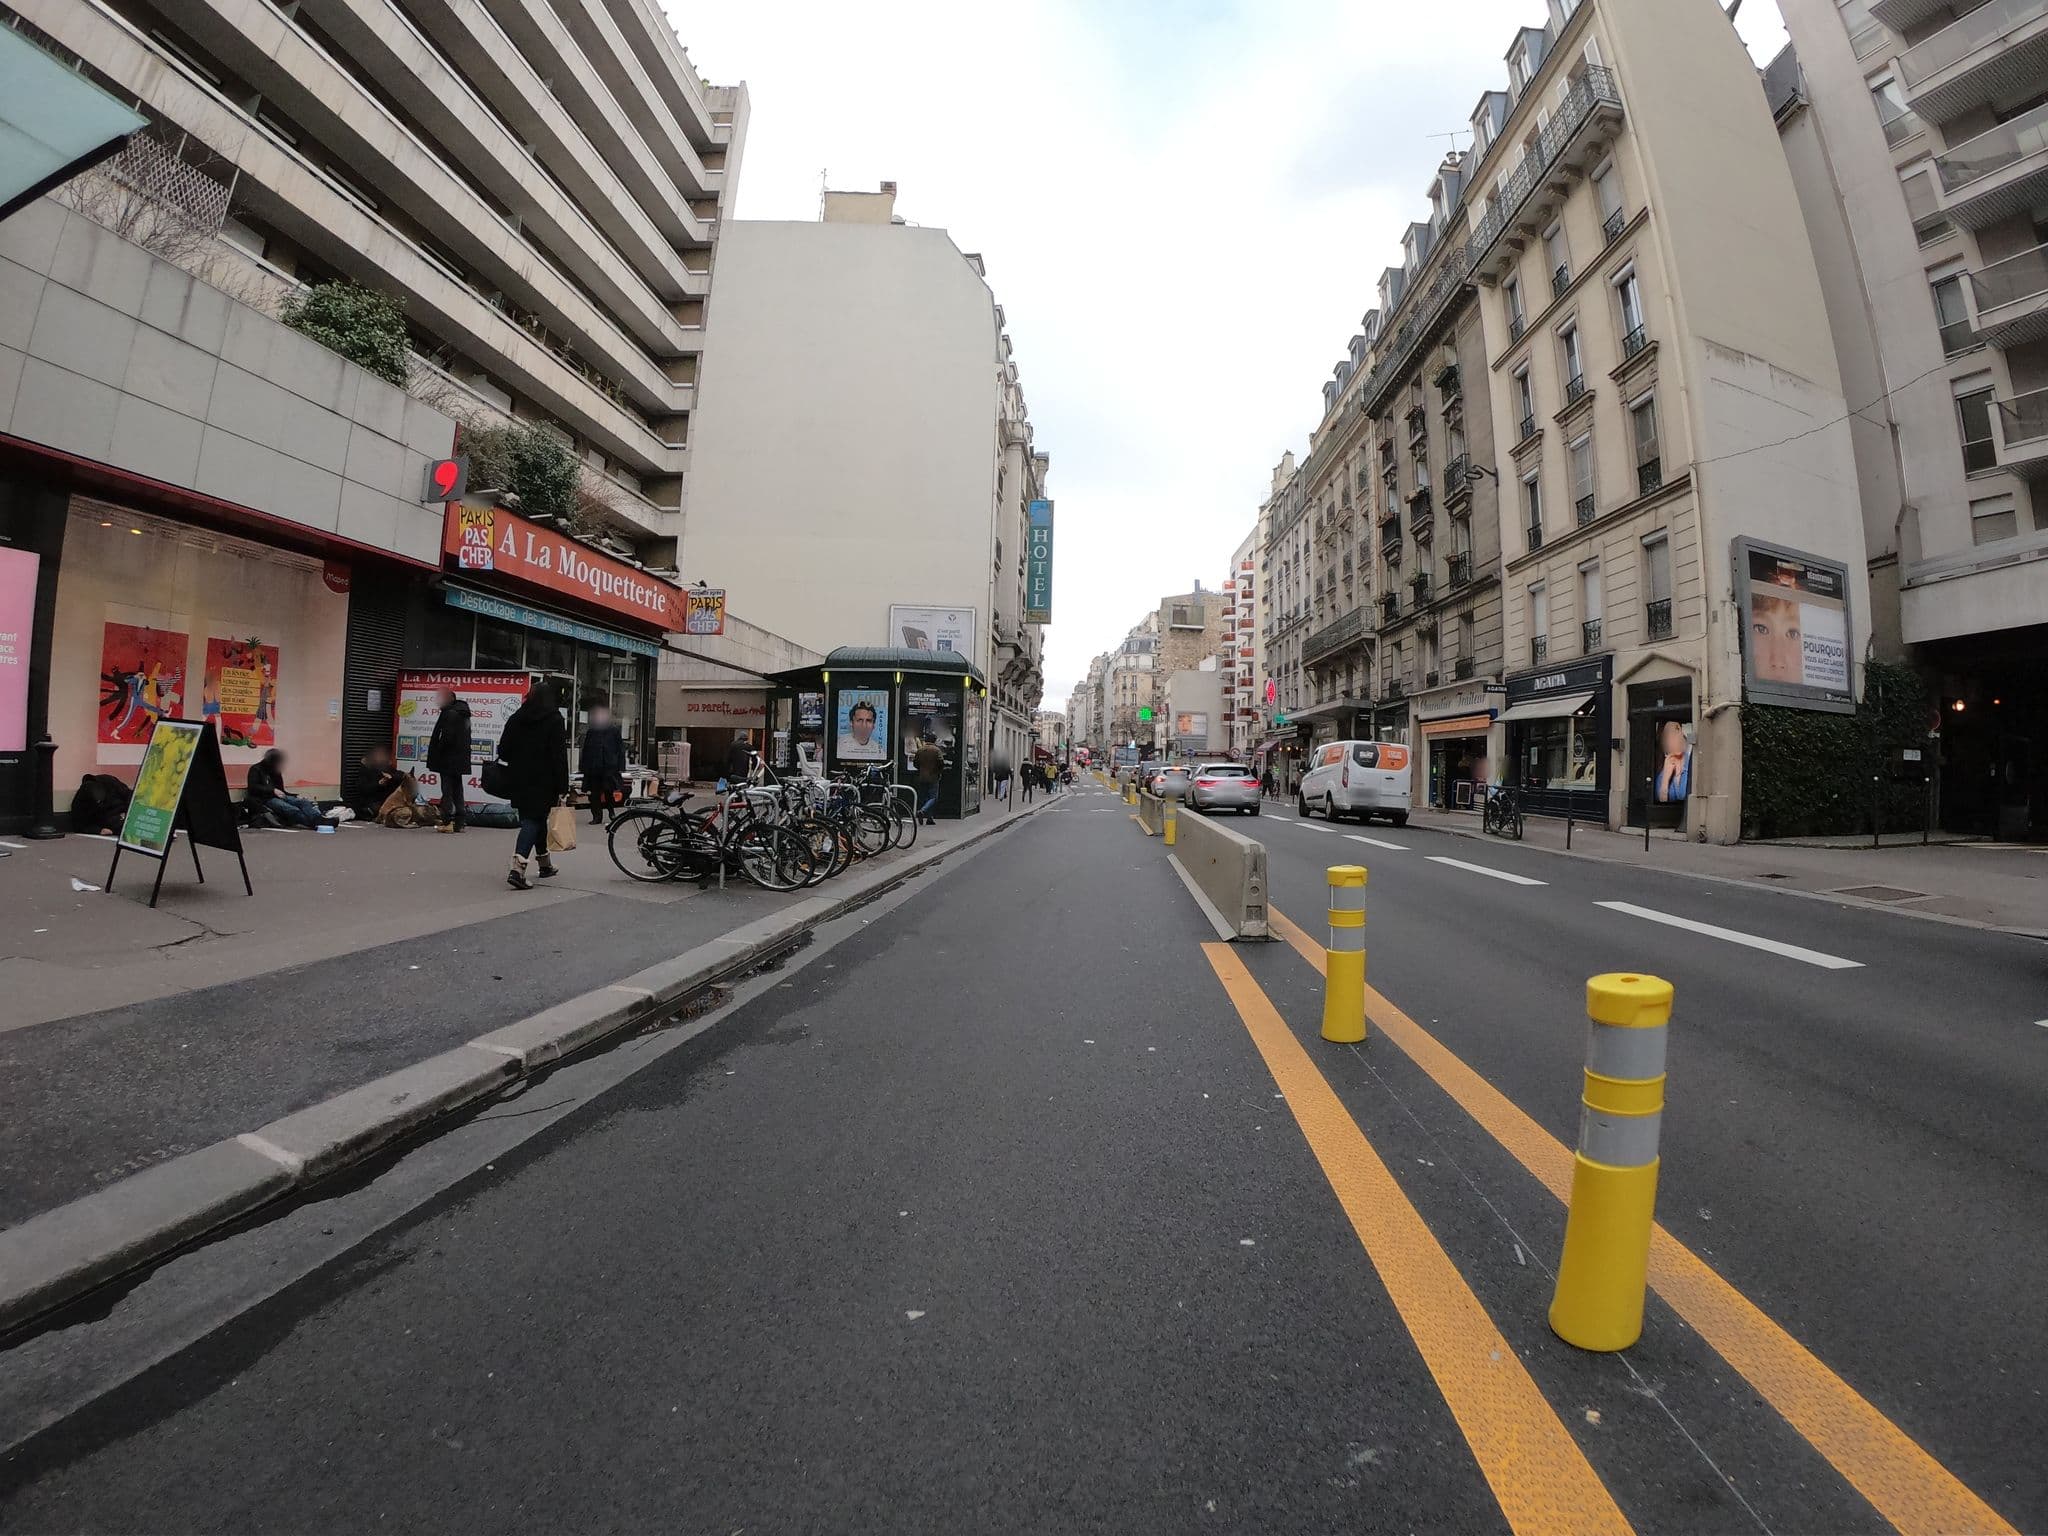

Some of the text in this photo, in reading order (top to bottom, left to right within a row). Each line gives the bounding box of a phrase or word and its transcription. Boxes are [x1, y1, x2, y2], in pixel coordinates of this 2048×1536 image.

[460, 505, 494, 527] PARIS
[465, 527, 488, 546] PAS
[460, 547, 493, 565] CHER
[499, 523, 666, 613] A La Moquetterie
[1033, 529, 1049, 607] HOTEL
[690, 596, 722, 610] PARIS
[460, 591, 516, 620] Déstockage
[522, 609, 538, 625] des
[542, 616, 574, 635] grandes
[694, 608, 717, 621] PAS
[688, 620, 720, 633] CHER
[1803, 640, 1845, 658] POURQUOI
[403, 672, 524, 688] La Moquetterie
[1533, 673, 1567, 690] AGATHA
[471, 710, 493, 718] SSÉS
[418, 773, 438, 786] 48
